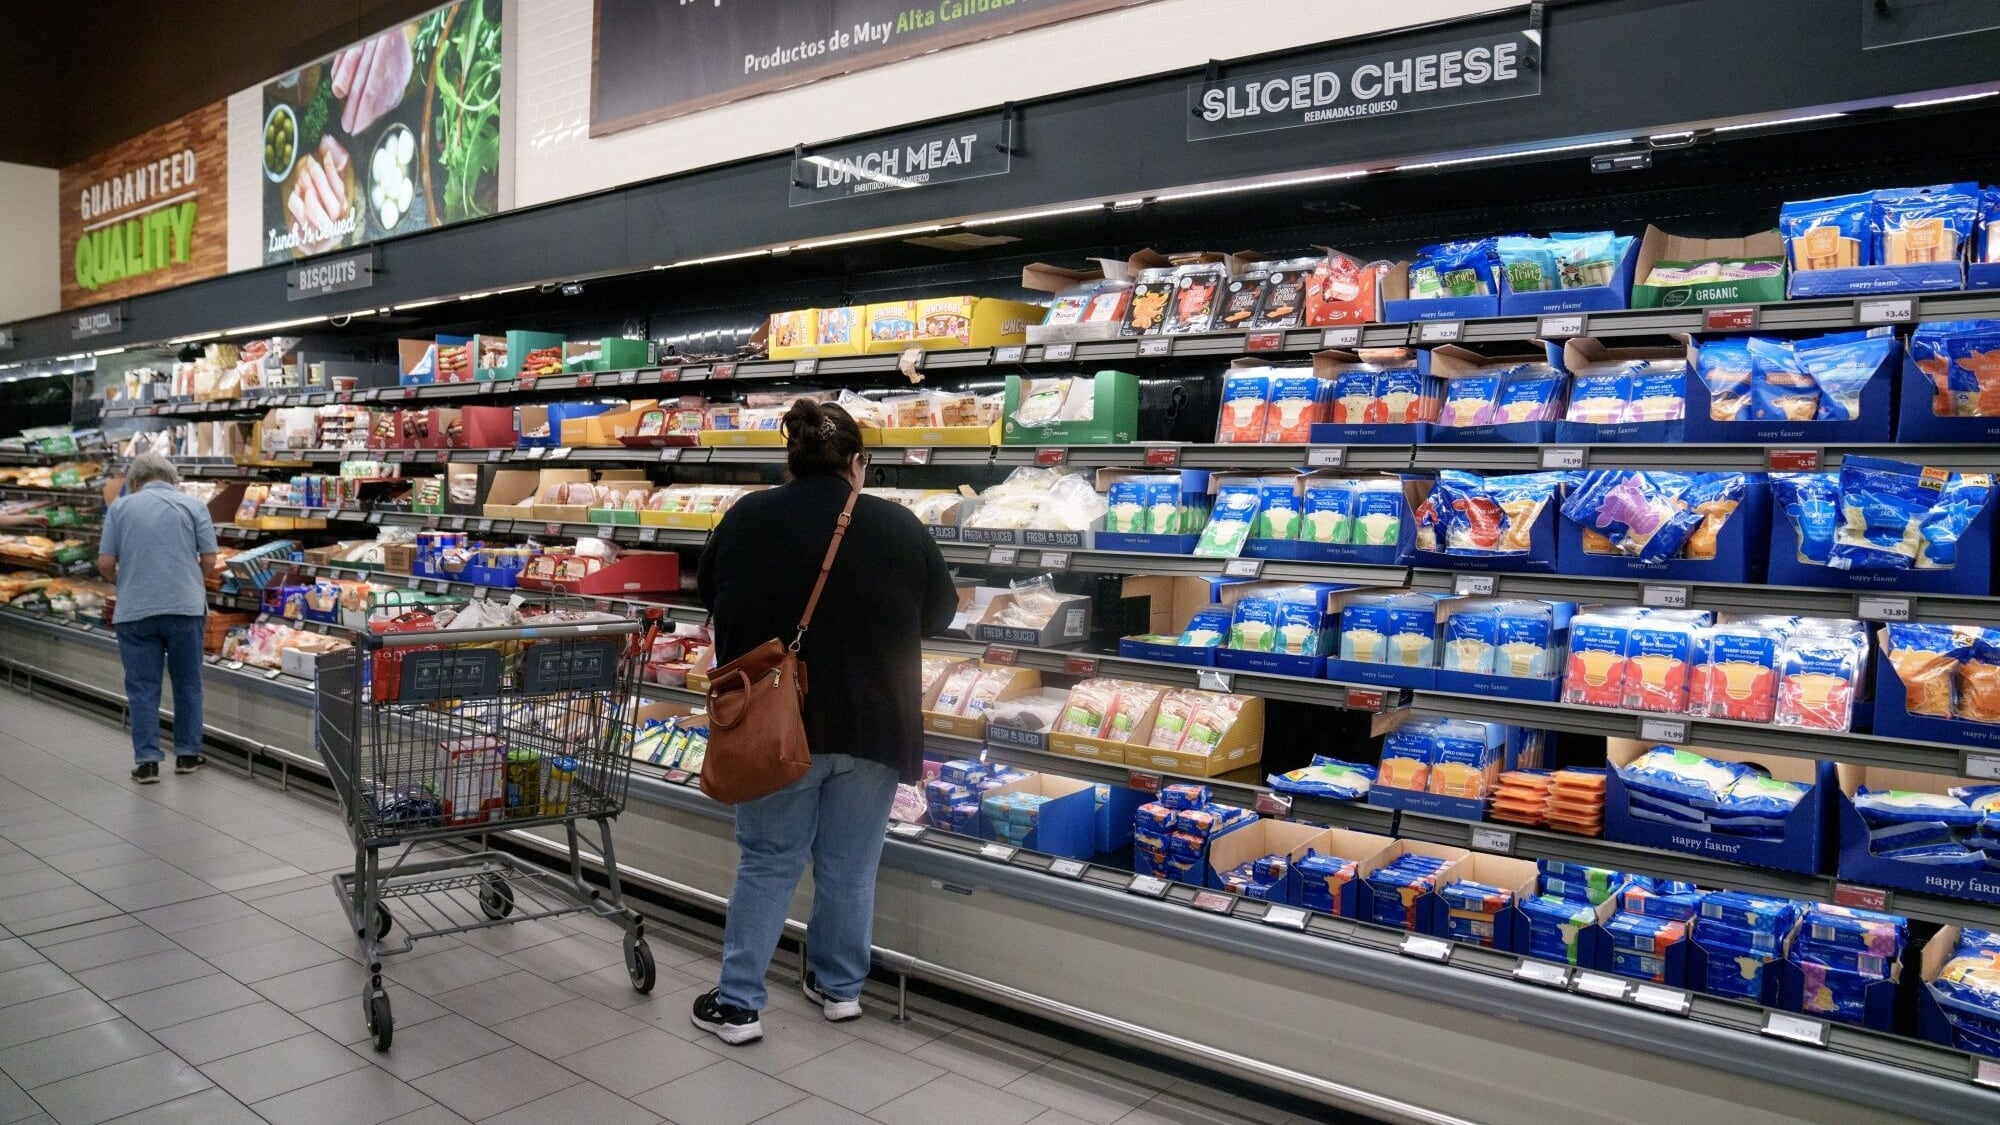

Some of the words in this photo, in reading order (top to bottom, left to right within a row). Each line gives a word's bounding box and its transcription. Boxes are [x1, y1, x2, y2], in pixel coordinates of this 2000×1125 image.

[744, 39, 825, 74] Productos
[829, 30, 850, 52] de
[853, 20, 892, 45] Muy
[896, 9, 935, 34] Alta
[1203, 71, 1341, 122] SLICED
[1351, 42, 1518, 100] CHEESE
[1304, 105, 1355, 123] REBANADAS
[1356, 103, 1368, 116] DE
[1368, 100, 1398, 115] QUESO
[816, 149, 899, 188] LUNCH
[906, 134, 977, 173] MEAT
[81, 149, 196, 220] GUARANTEED
[268, 222, 300, 253] Lunch
[75, 201, 197, 291] QUALITY
[299, 259, 356, 291] BISCUITS
[1696, 286, 1738, 300] ORGANIC
[1885, 310, 1910, 318] $3.45
[1561, 325, 1580, 333] $2.79
[1797, 459, 1816, 467] $2.19
[1920, 480, 1942, 490] BAG
[935, 527, 956, 538] SLICED
[964, 529, 983, 541] FRESH
[991, 530, 1012, 542] SLICED
[1026, 532, 1047, 544] FRESH
[1056, 532, 1078, 544] SLICED
[1473, 584, 1492, 592] $2.95
[1664, 596, 1685, 604] $2.95
[1883, 607, 1908, 617] $3.89
[983, 626, 1003, 639] FRESH
[1012, 630, 1035, 642] SLICED
[990, 727, 1009, 740] FRESH
[1017, 732, 1039, 745] SLICED
[1663, 730, 1683, 738] $1.99
[1671, 835, 1702, 850] Happy
[1704, 838, 1738, 853] farms
[1925, 875, 1964, 892] Happy
[1863, 897, 1884, 906] $6.79
